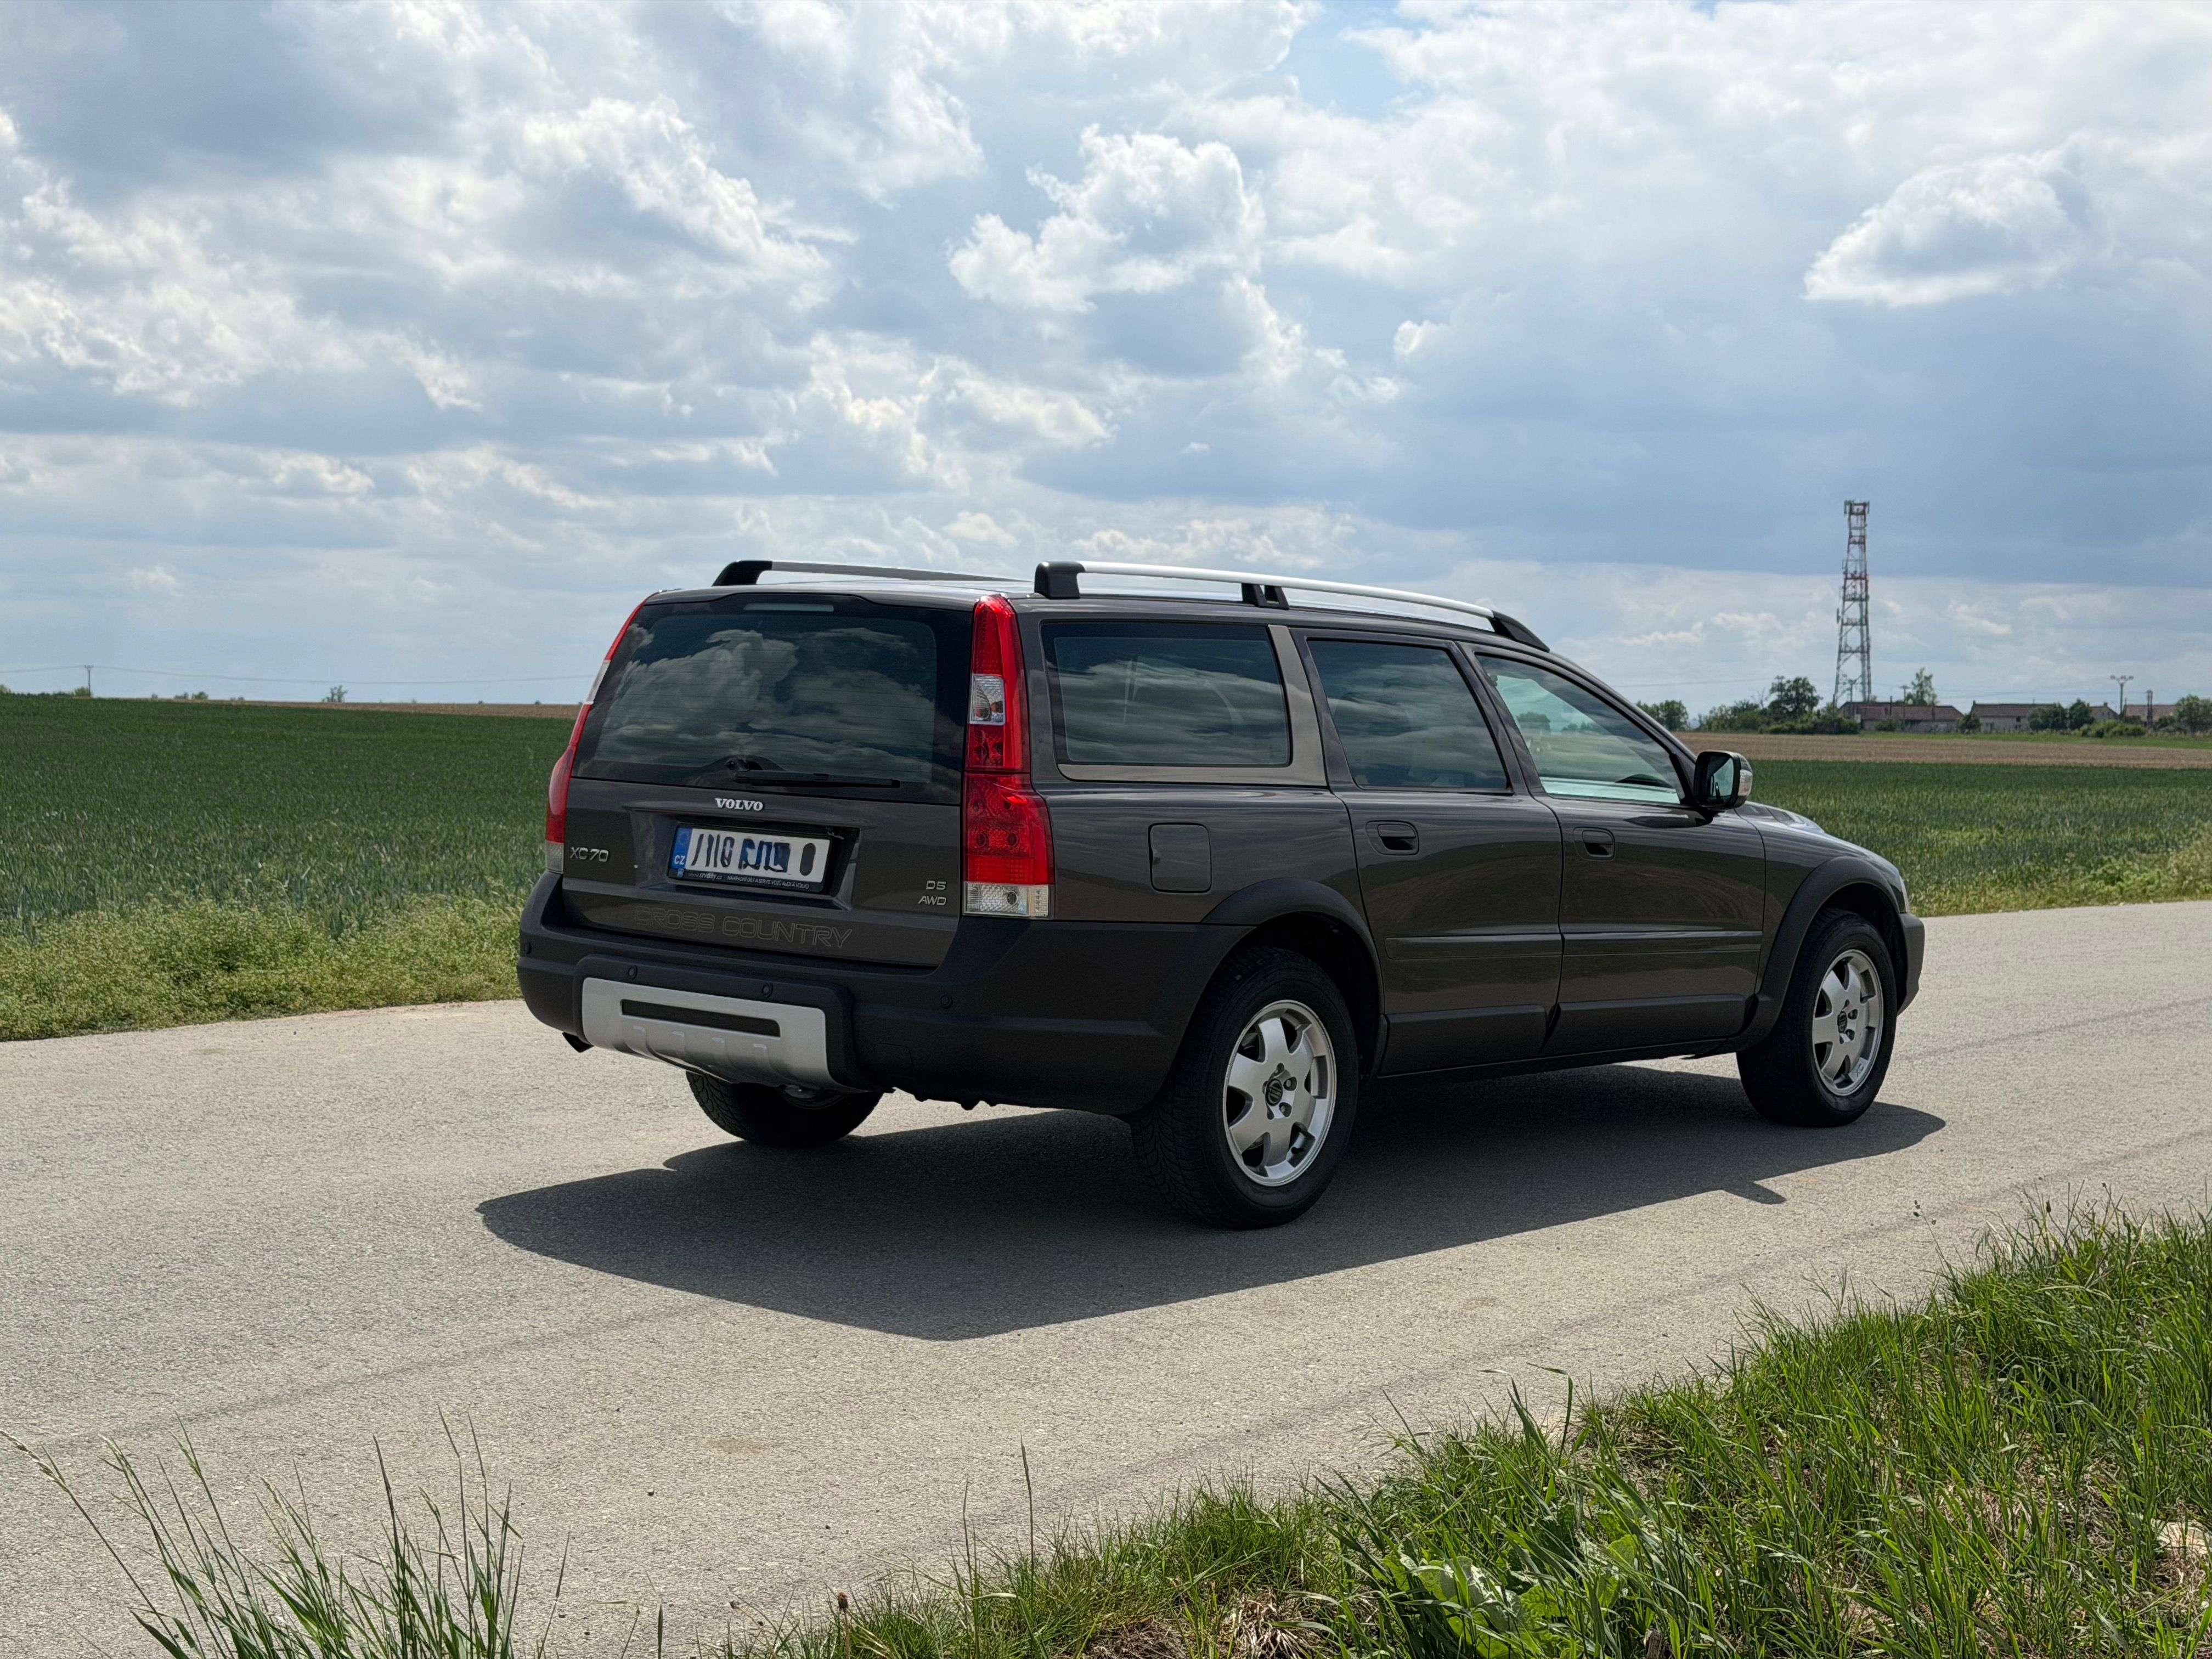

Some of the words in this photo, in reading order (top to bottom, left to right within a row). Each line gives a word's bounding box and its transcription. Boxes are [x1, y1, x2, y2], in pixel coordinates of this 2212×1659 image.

[715, 798, 763, 811] VOLVO
[674, 855, 685, 865] CZ
[926, 880, 946, 890] D5
[918, 895, 946, 906] AWD
[634, 906, 715, 933] CROSS
[722, 916, 853, 948] COUNTRY
